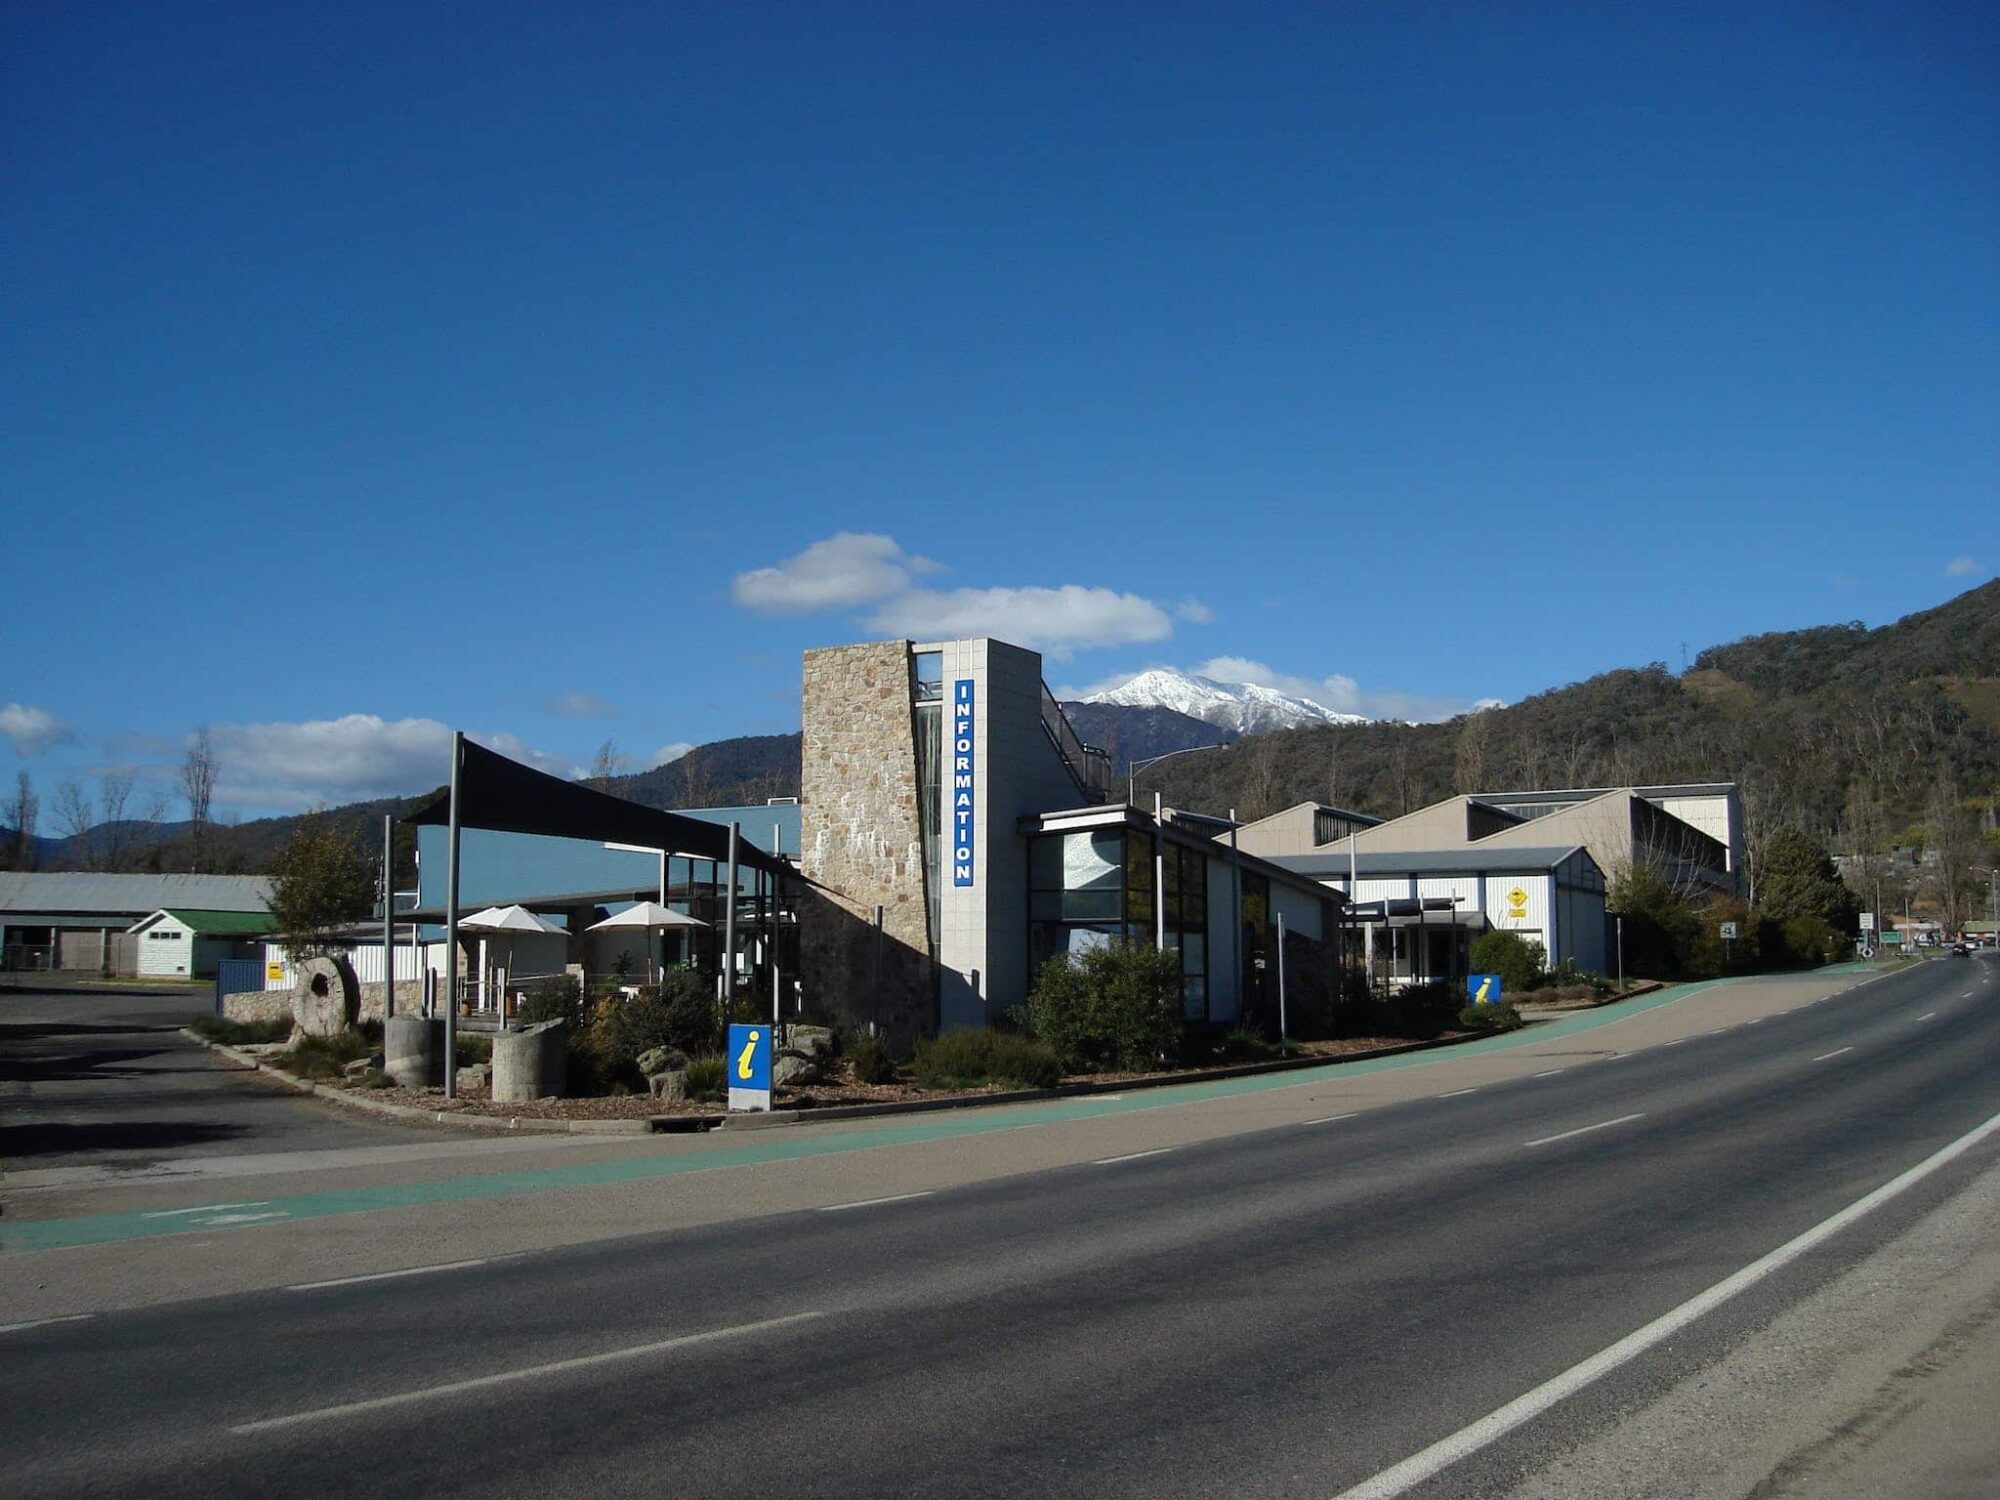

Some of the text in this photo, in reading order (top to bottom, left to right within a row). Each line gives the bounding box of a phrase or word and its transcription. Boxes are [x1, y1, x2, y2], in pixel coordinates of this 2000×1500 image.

[955, 685, 971, 879] INFORMATION
[1475, 977, 1491, 1006] i
[737, 1030, 760, 1079] i
